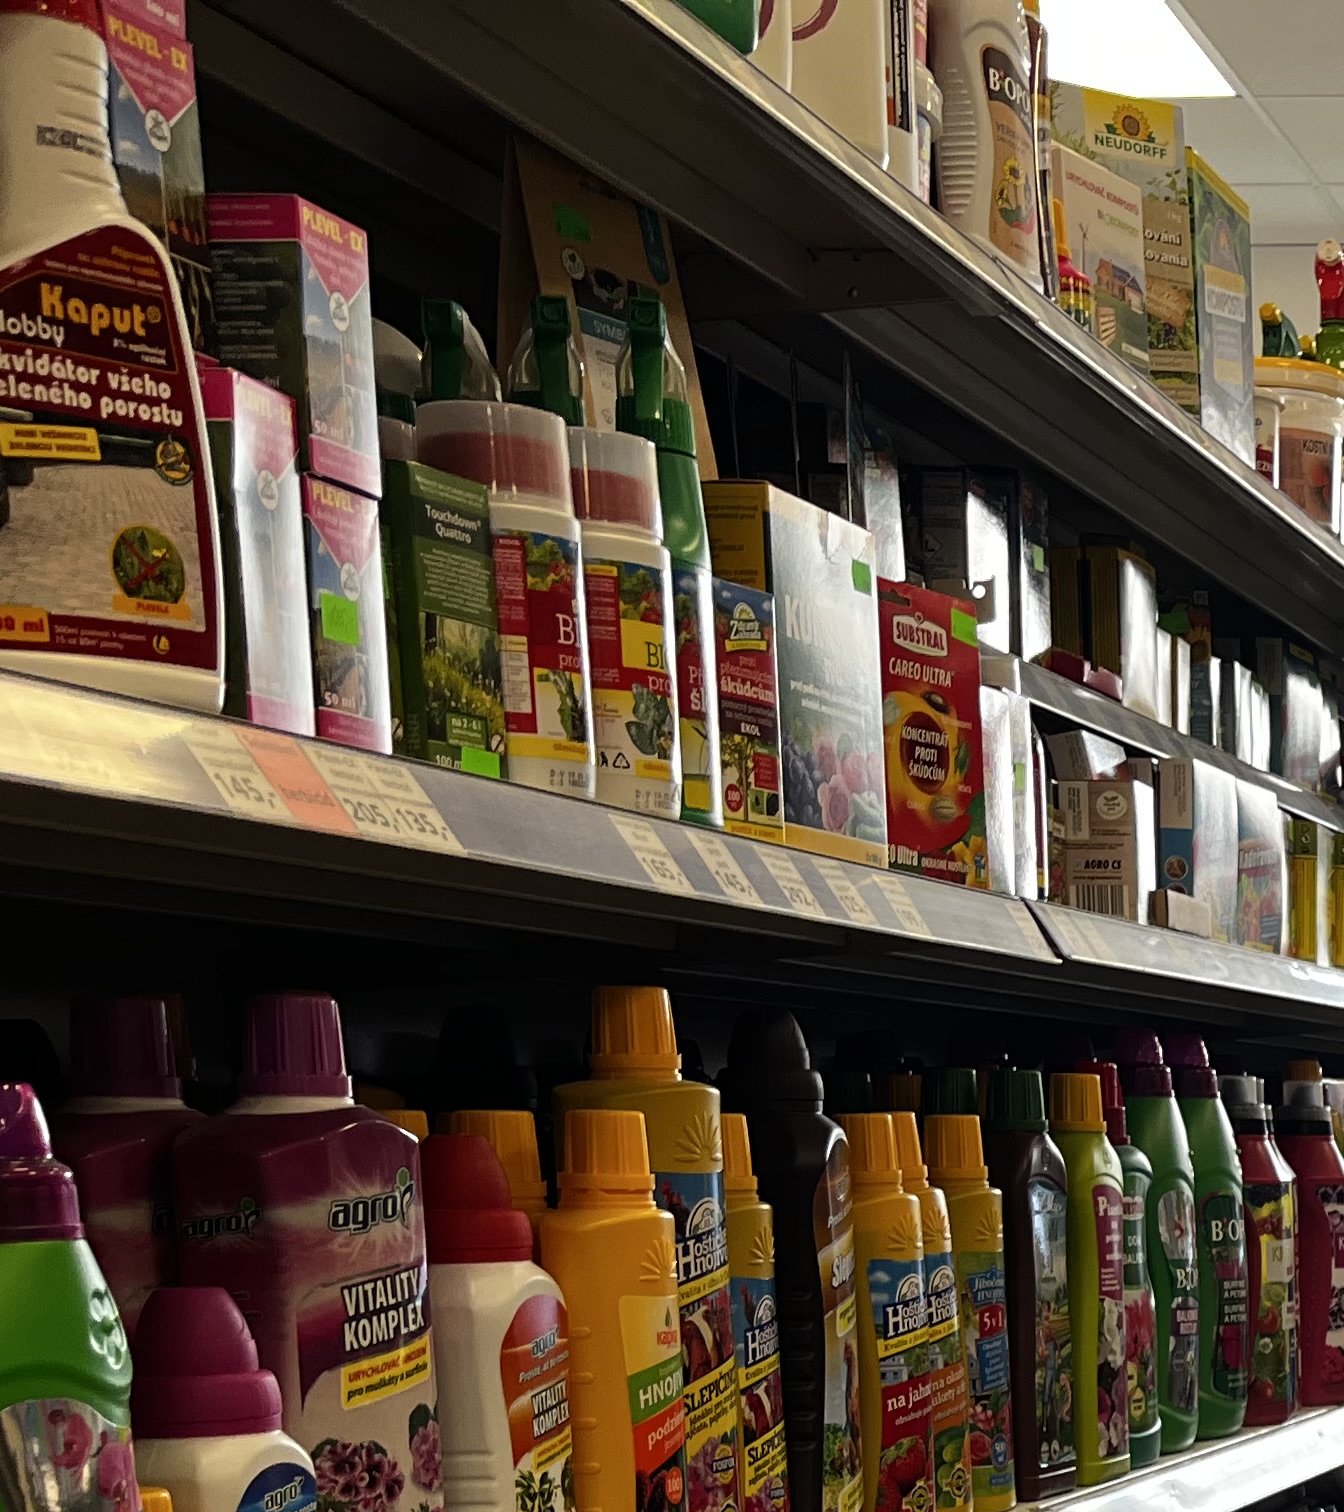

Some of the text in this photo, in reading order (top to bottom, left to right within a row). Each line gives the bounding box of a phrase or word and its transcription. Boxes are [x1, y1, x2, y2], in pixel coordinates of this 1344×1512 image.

[1094, 132, 1168, 160] NEUDORFF
[302, 206, 343, 244] PLEVEL
[40, 282, 148, 337] Kaput
[108, 367, 172, 399] všeho
[100, 397, 183, 428] porostu
[425, 504, 478, 532] Touchdown
[435, 523, 472, 544] Quattro
[896, 619, 946, 650] SUBSTRAL
[888, 657, 952, 687] CAREO ULTRA
[720, 677, 774, 701] škůdcům
[901, 724, 949, 745] KONCENTRÁT
[915, 738, 938, 763] PROTI
[908, 759, 946, 782] ŠKŮDCŮM
[1083, 859, 1108, 870] AGRO
[342, 1268, 420, 1316] VITALITY
[344, 1302, 425, 1351] KOMPLEX
[531, 1379, 567, 1413] VITALITY
[887, 1393, 904, 1412] na
[533, 1405, 570, 1439] KOMPLEX
[264, 1476, 304, 1512] agro
